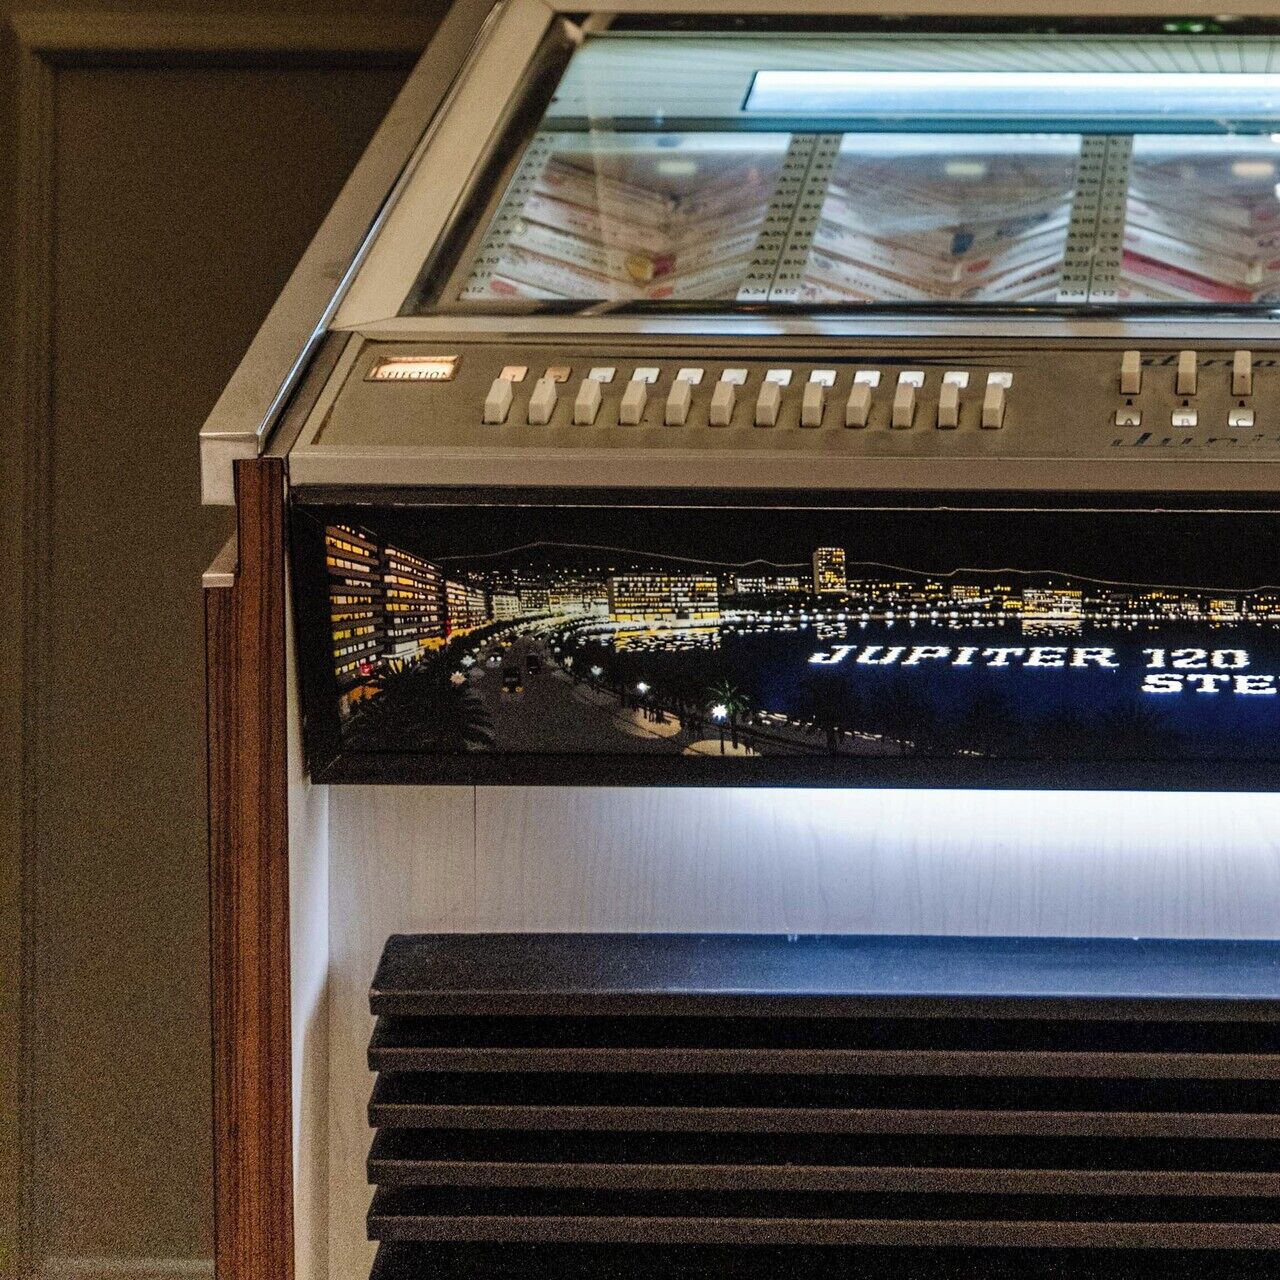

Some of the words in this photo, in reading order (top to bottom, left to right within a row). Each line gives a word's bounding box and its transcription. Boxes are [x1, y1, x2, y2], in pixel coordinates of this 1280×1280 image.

[379, 370, 449, 380] SELECTION
[807, 644, 1120, 667] JUPITER
[1142, 648, 1251, 669] 120
